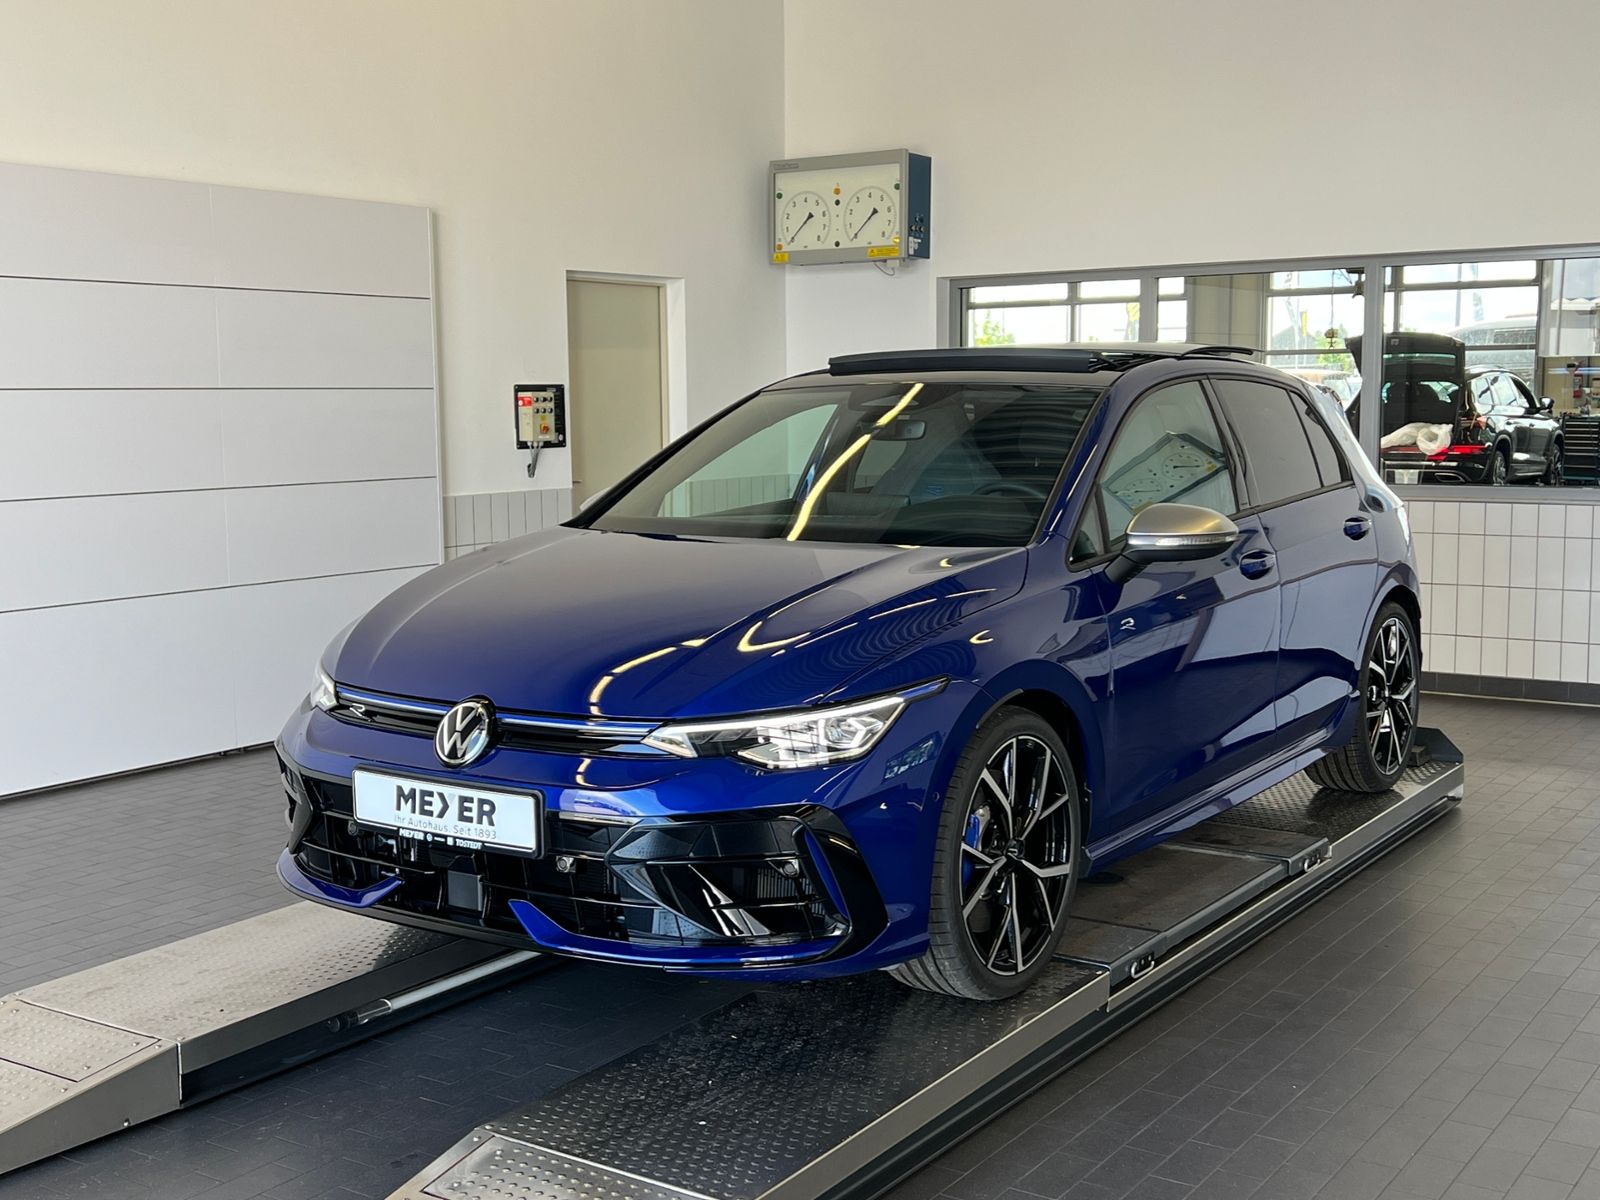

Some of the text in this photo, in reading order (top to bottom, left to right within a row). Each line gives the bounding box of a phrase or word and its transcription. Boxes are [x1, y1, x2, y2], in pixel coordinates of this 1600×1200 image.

[396, 785, 496, 826] MEYER
[454, 824, 471, 836] Seit
[474, 826, 497, 840] 1893
